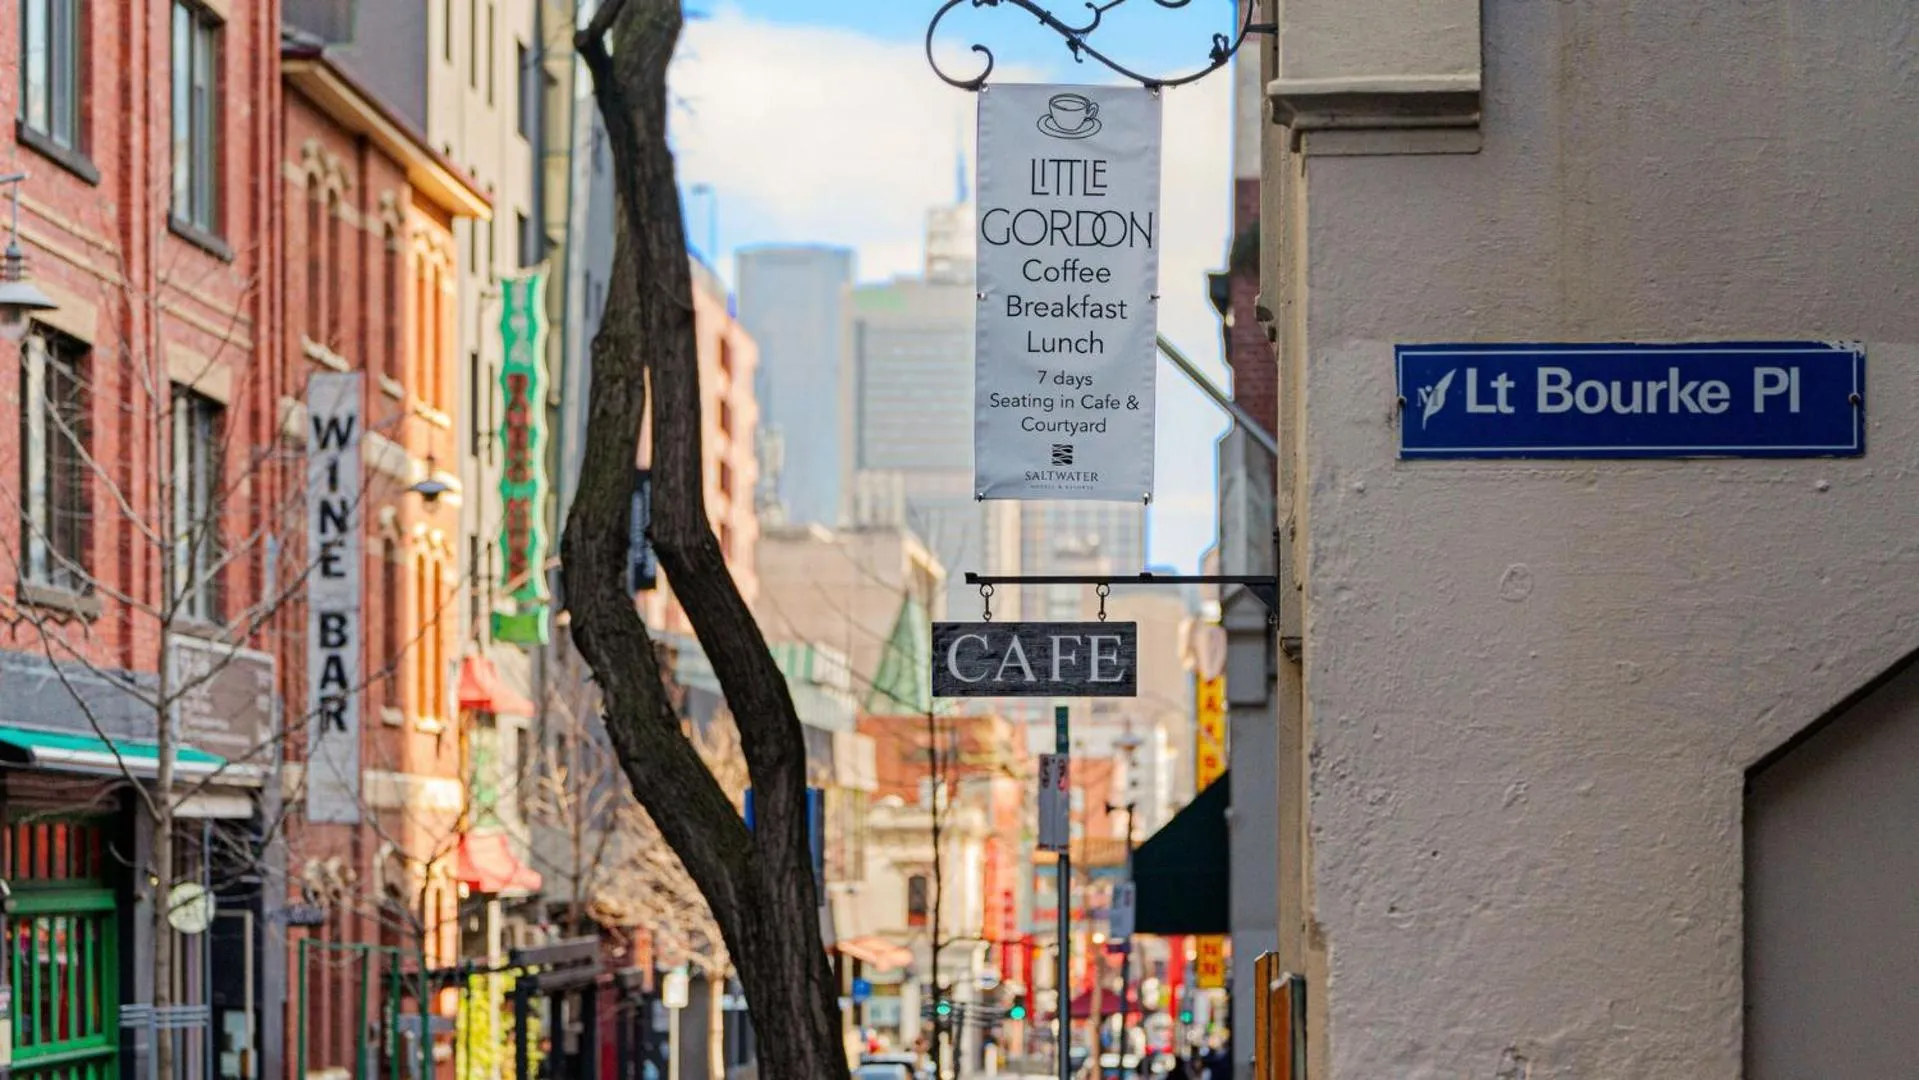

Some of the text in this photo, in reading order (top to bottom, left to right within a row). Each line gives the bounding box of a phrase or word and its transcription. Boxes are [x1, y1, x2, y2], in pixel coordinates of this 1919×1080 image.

[1031, 158, 1108, 196] LITTLE
[981, 207, 1153, 249] GORDON
[1022, 258, 1111, 283] Coffee
[1006, 294, 1128, 319] Breakfast
[1027, 330, 1104, 354] Lunch
[1037, 370, 1093, 390] 7 days
[1466, 366, 1800, 413] Lt Bourke Pl
[989, 392, 1140, 412] Seating in Cafe &
[1021, 416, 1107, 437] Courtyard
[1024, 470, 1099, 482] SALTWATER
[313, 415, 354, 578] WINE
[947, 634, 1125, 683] CAFE
[319, 612, 347, 733] BAR
